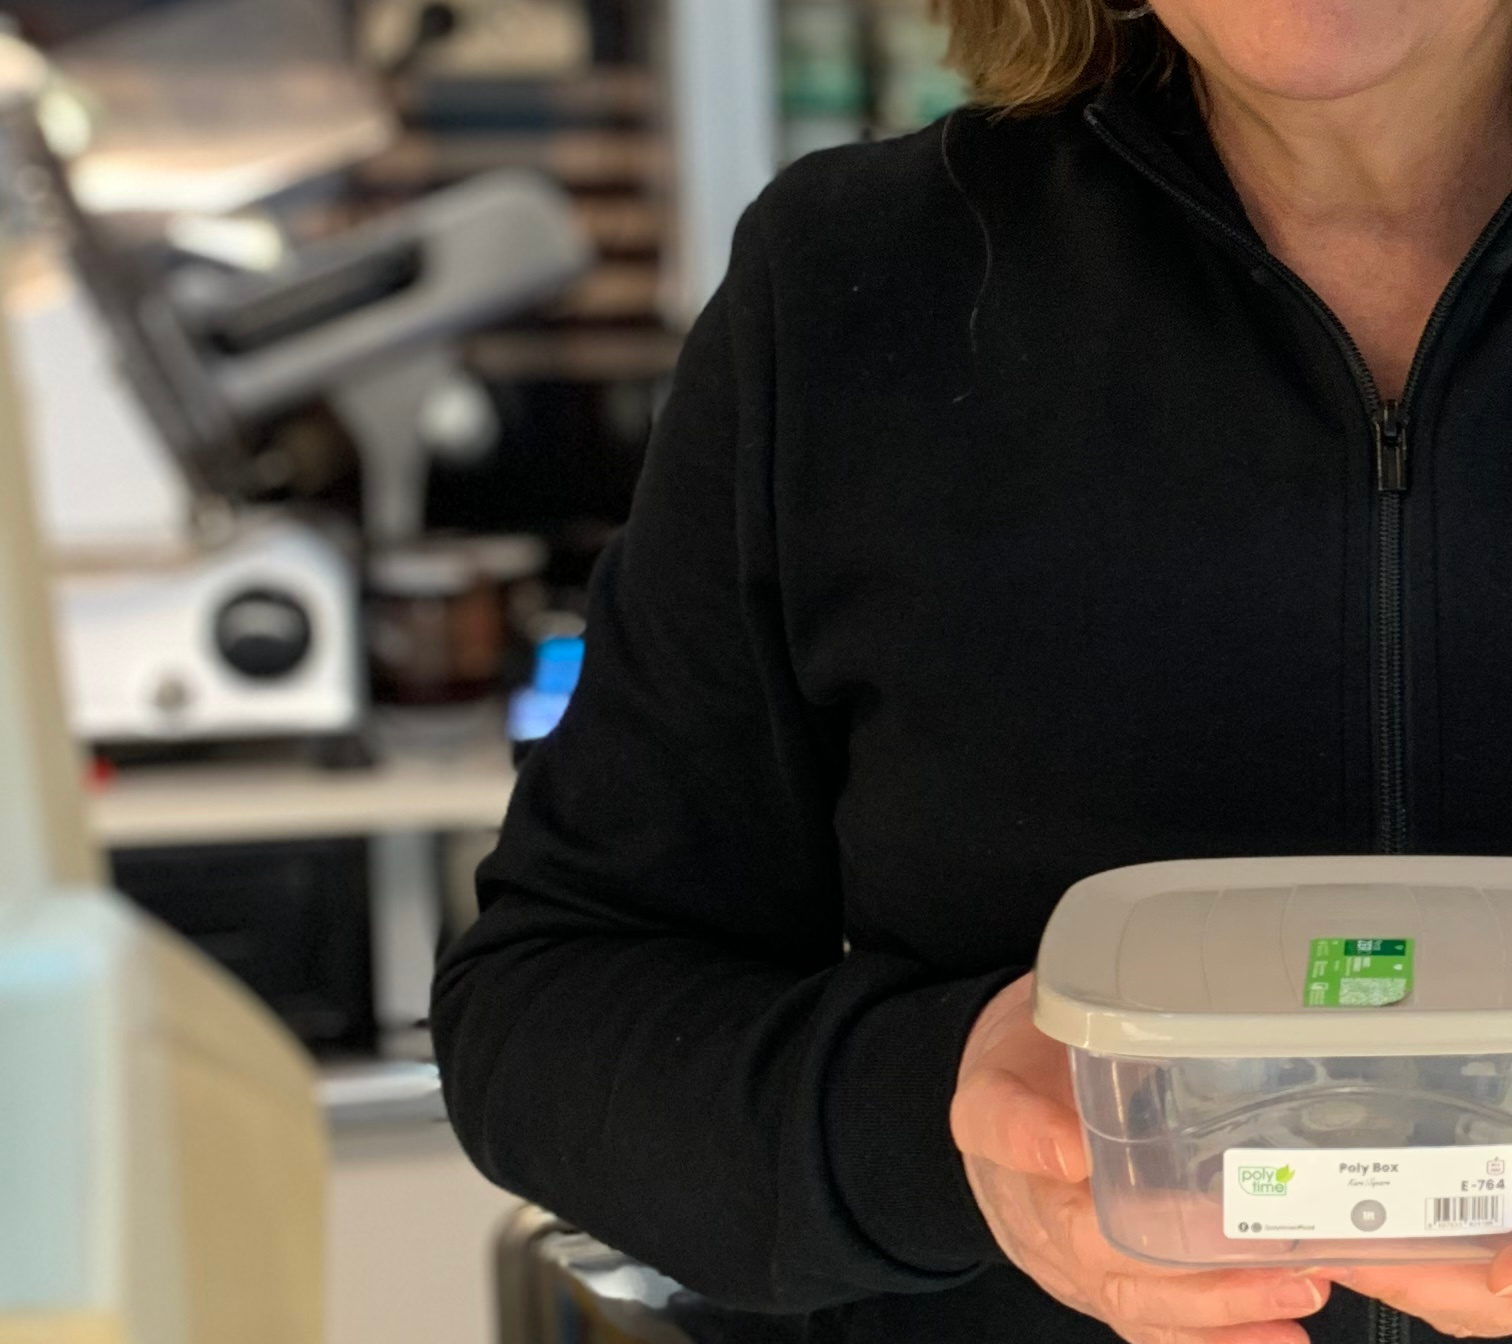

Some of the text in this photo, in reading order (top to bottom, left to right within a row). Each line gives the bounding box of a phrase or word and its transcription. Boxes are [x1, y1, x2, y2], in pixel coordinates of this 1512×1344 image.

[1242, 1167, 1274, 1183] poly
[1339, 1162, 1399, 1176] Poly Box
[1252, 1181, 1284, 1193] time
